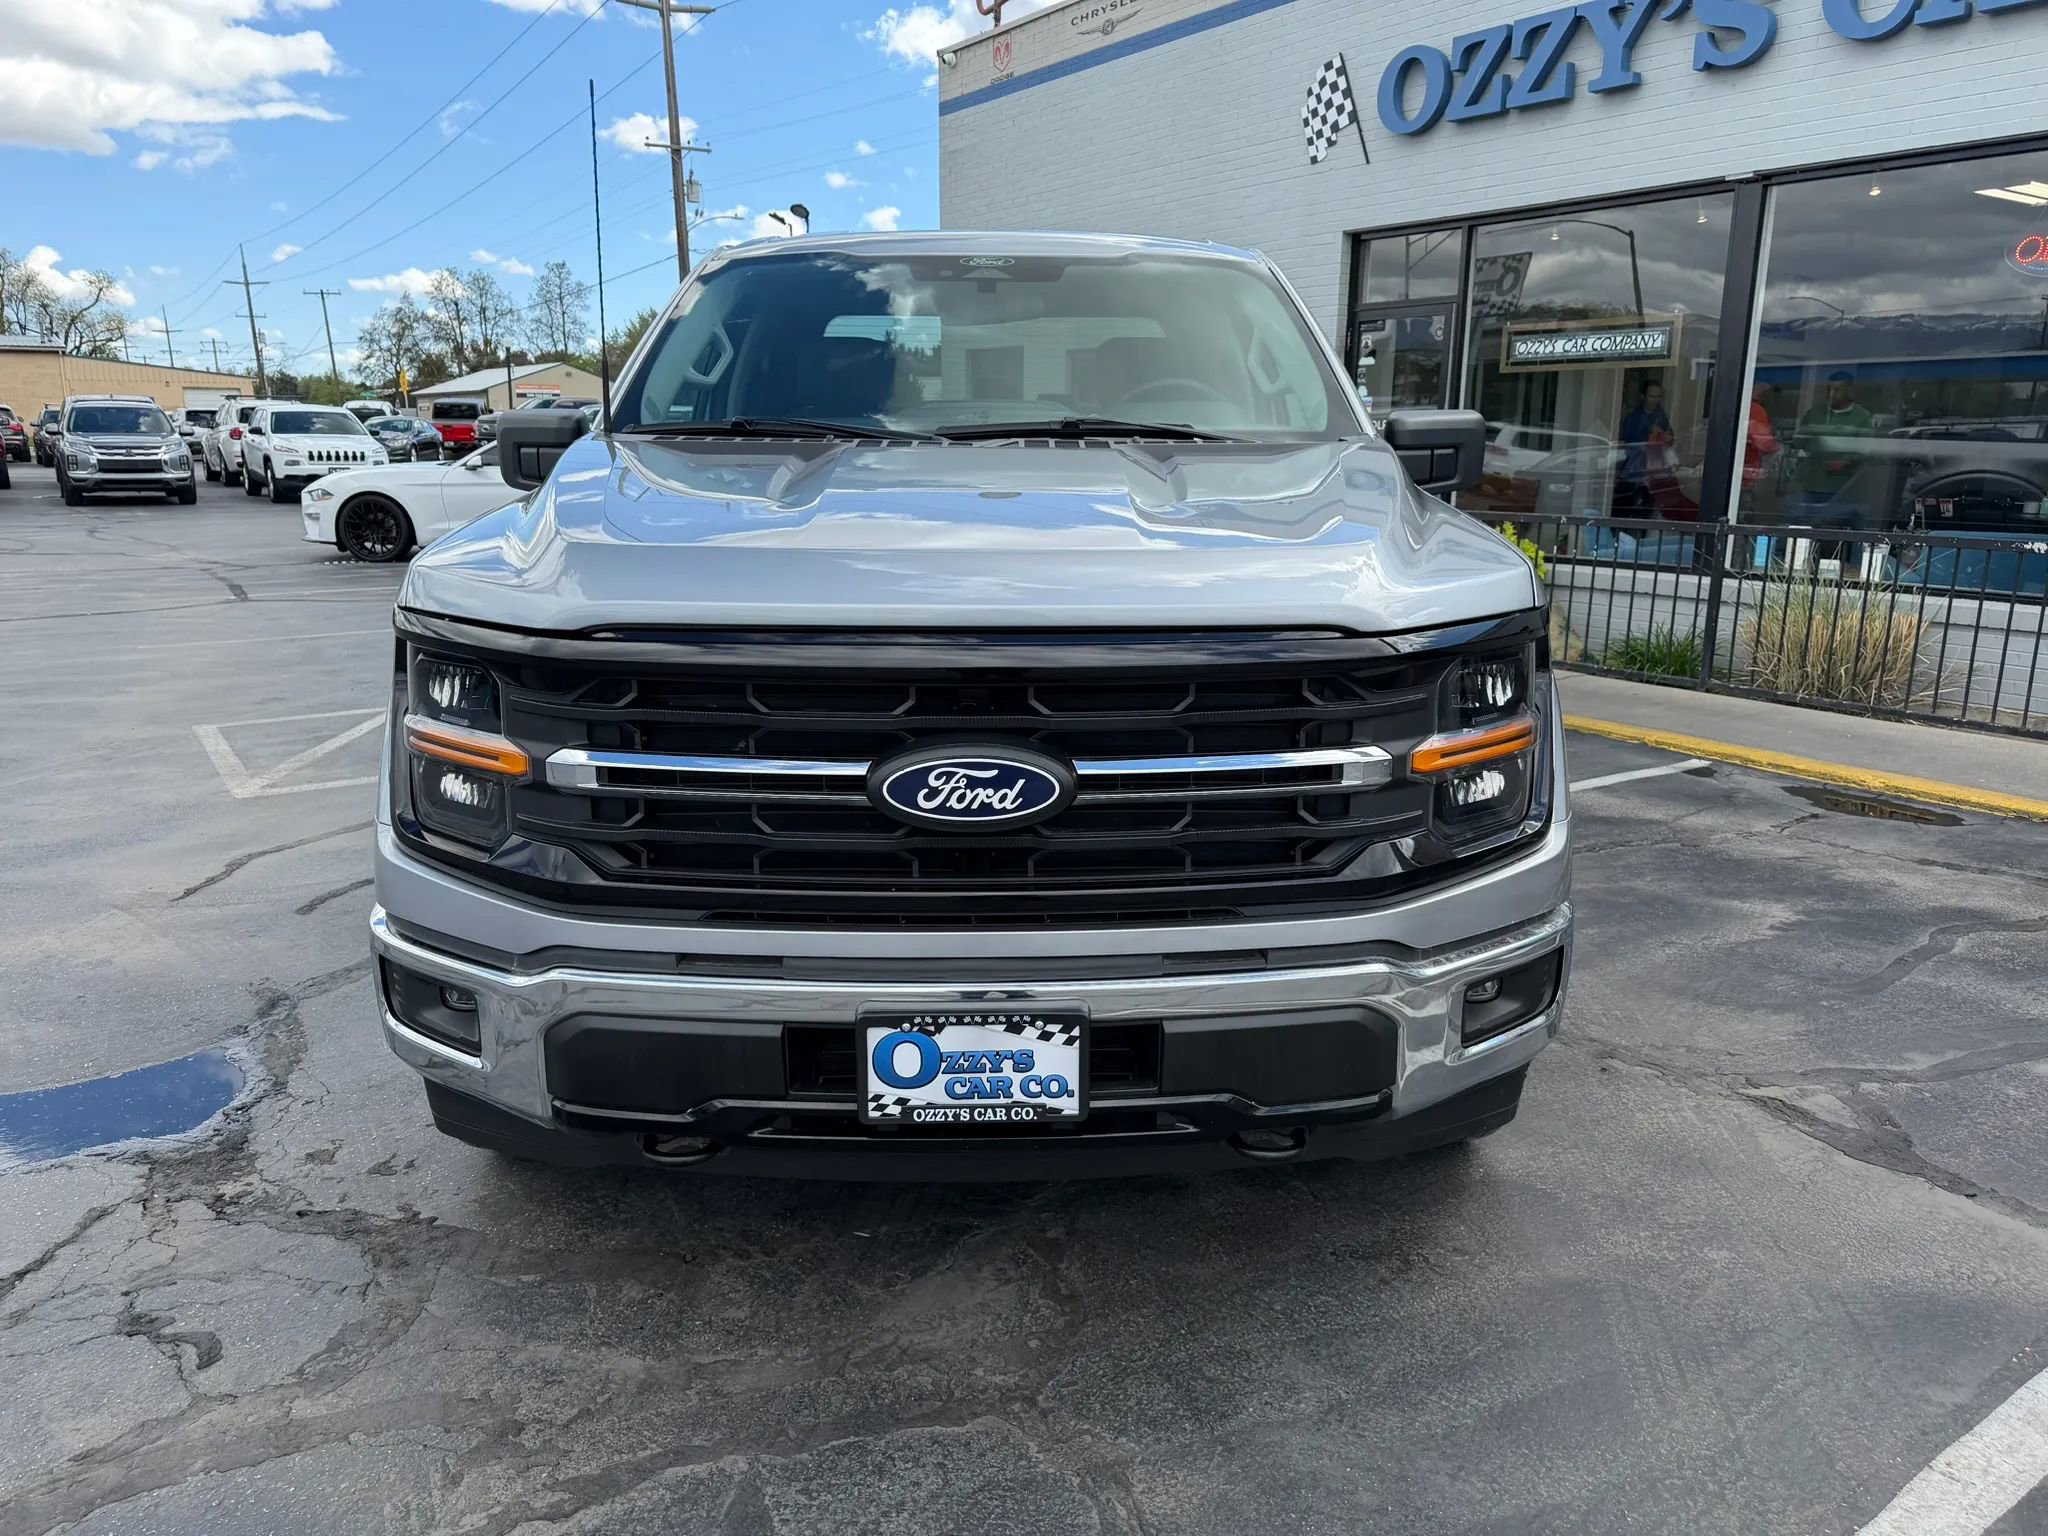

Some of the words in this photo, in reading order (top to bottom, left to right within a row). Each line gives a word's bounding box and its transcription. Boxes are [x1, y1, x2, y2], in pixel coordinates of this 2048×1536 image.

[1071, 0, 1138, 26] CHRYSL
[991, 72, 1014, 84] DODGE
[1377, 0, 1777, 135] OZZY'S
[1562, 338, 1587, 352] CAR
[1591, 333, 1661, 351] COMPANY
[917, 767, 1026, 809] Ford
[872, 1031, 1035, 1089] OZZY'S
[944, 1076, 1013, 1100] CAR
[1019, 1074, 1075, 1098] CO.
[913, 1107, 970, 1122] OZZY'S
[974, 1107, 1007, 1121] CAR
[1011, 1106, 1038, 1121] CO.
